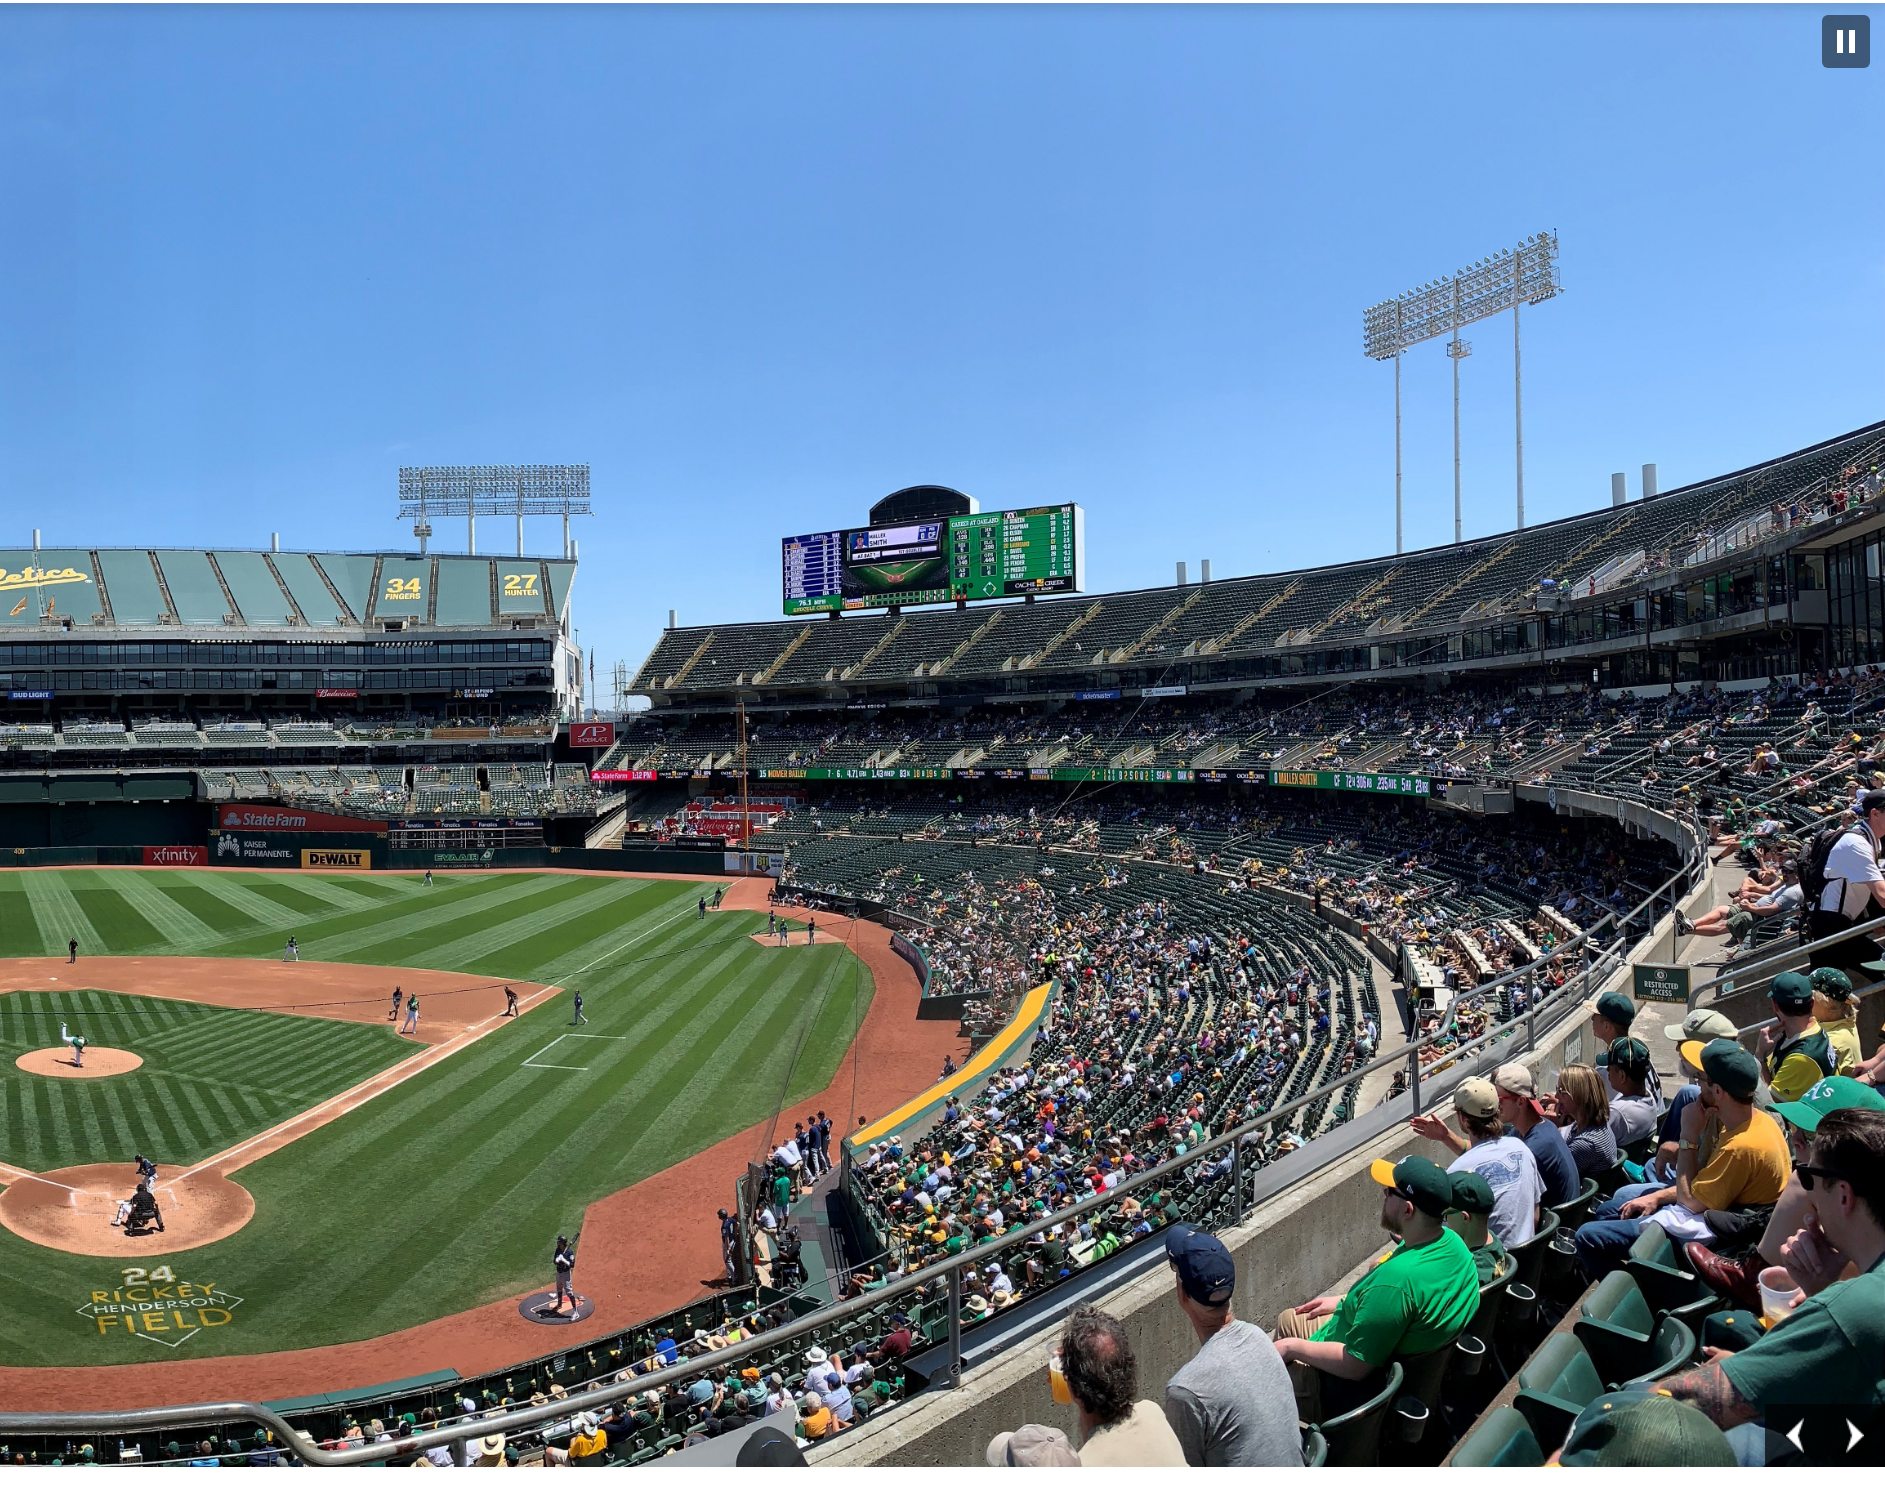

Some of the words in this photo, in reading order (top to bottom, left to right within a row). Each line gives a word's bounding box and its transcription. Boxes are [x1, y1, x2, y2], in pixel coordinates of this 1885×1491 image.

[977, 517, 999, 525] OAKLAND
[870, 539, 887, 547] SMITH
[386, 578, 422, 594] 34
[503, 574, 538, 590] 27
[384, 592, 421, 600] FINGERS
[317, 689, 357, 698] Budweiser
[643, 771, 652, 779] PM
[760, 769, 767, 778] 15
[768, 769, 788, 778] HOMER
[788, 769, 807, 778] BAILEY
[847, 769, 858, 778] 4.71
[1156, 771, 1165, 780] SEA
[1278, 772, 1298, 785] MALLEX
[1299, 773, 1318, 786] SMITH
[1334, 774, 1341, 787] CF
[243, 812, 307, 827] StateFarm
[243, 840, 267, 848] KAISER
[243, 850, 291, 858] PERMANENTE
[550, 846, 562, 854] 367
[152, 848, 198, 864] xfinity
[757, 855, 770, 866] 811
[1644, 980, 1679, 990] RESTRICTED
[1650, 988, 1673, 997] ACCESS
[1802, 1078, 1835, 1101] A's
[121, 1265, 177, 1287] 24
[91, 1282, 216, 1303] RICKEY
[93, 1296, 226, 1314] HENDERSON
[97, 1308, 233, 1335] FIELD
